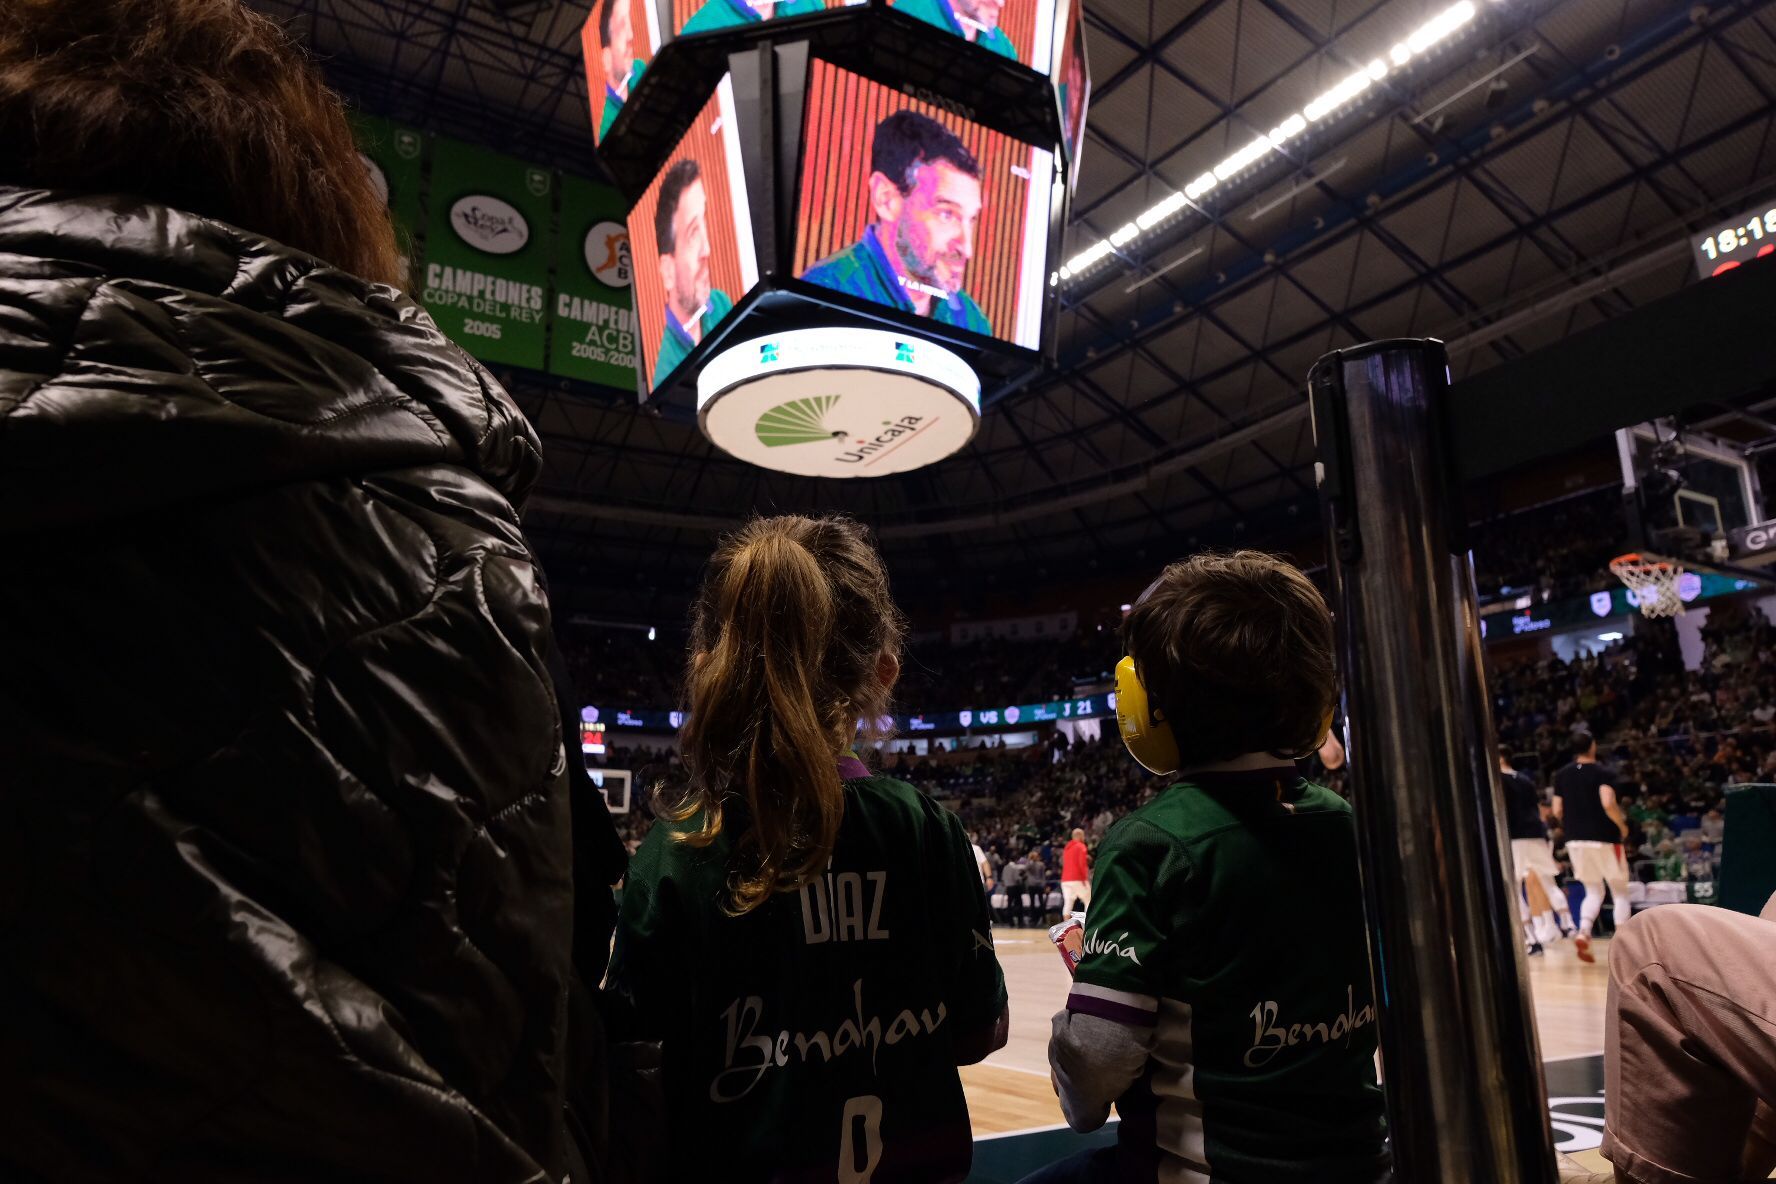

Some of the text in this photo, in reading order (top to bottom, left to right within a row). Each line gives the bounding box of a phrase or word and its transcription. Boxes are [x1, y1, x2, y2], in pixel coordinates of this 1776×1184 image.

[426, 263, 543, 311] CAMPEONES
[422, 288, 545, 325] COPA DEL REY
[463, 318, 502, 340] 2005
[585, 325, 633, 354] ACB
[571, 341, 637, 369] 2005/200
[834, 415, 924, 465] Unicaja
[1077, 700, 1093, 715] 21
